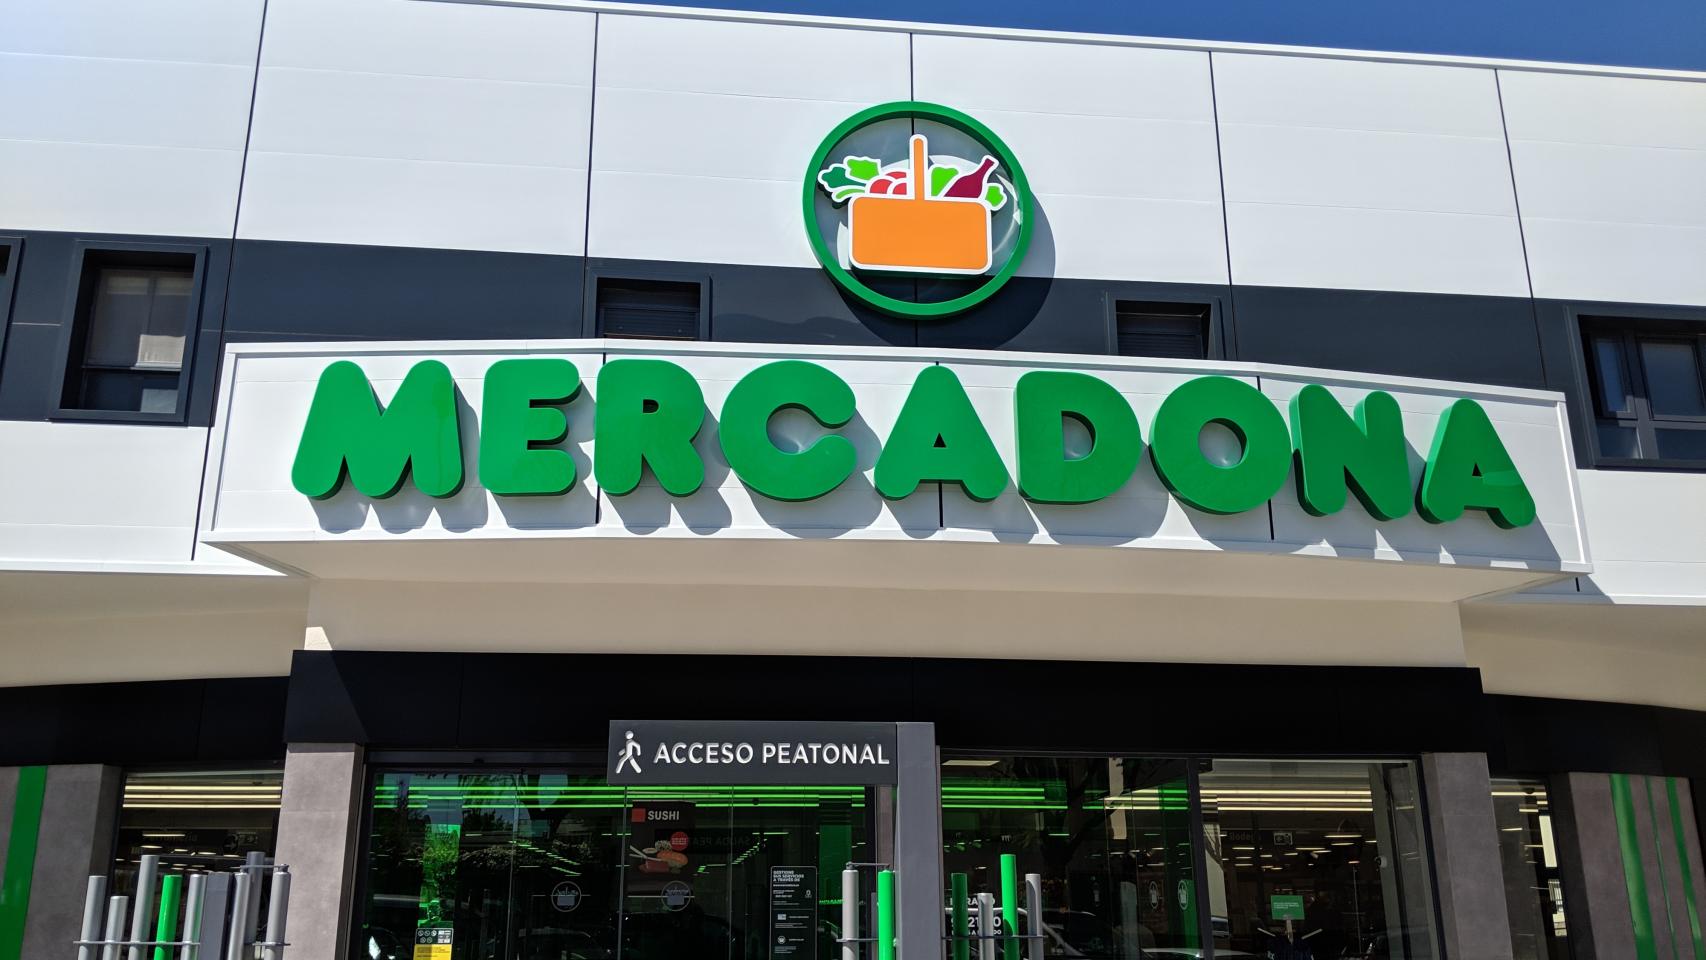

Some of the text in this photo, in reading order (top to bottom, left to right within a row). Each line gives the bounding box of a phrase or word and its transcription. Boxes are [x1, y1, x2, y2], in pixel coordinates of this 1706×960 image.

[291, 358, 1537, 529] MERCADONA
[653, 742, 890, 765] ACCESO PEATONAL
[647, 810, 680, 821] SUSHI
